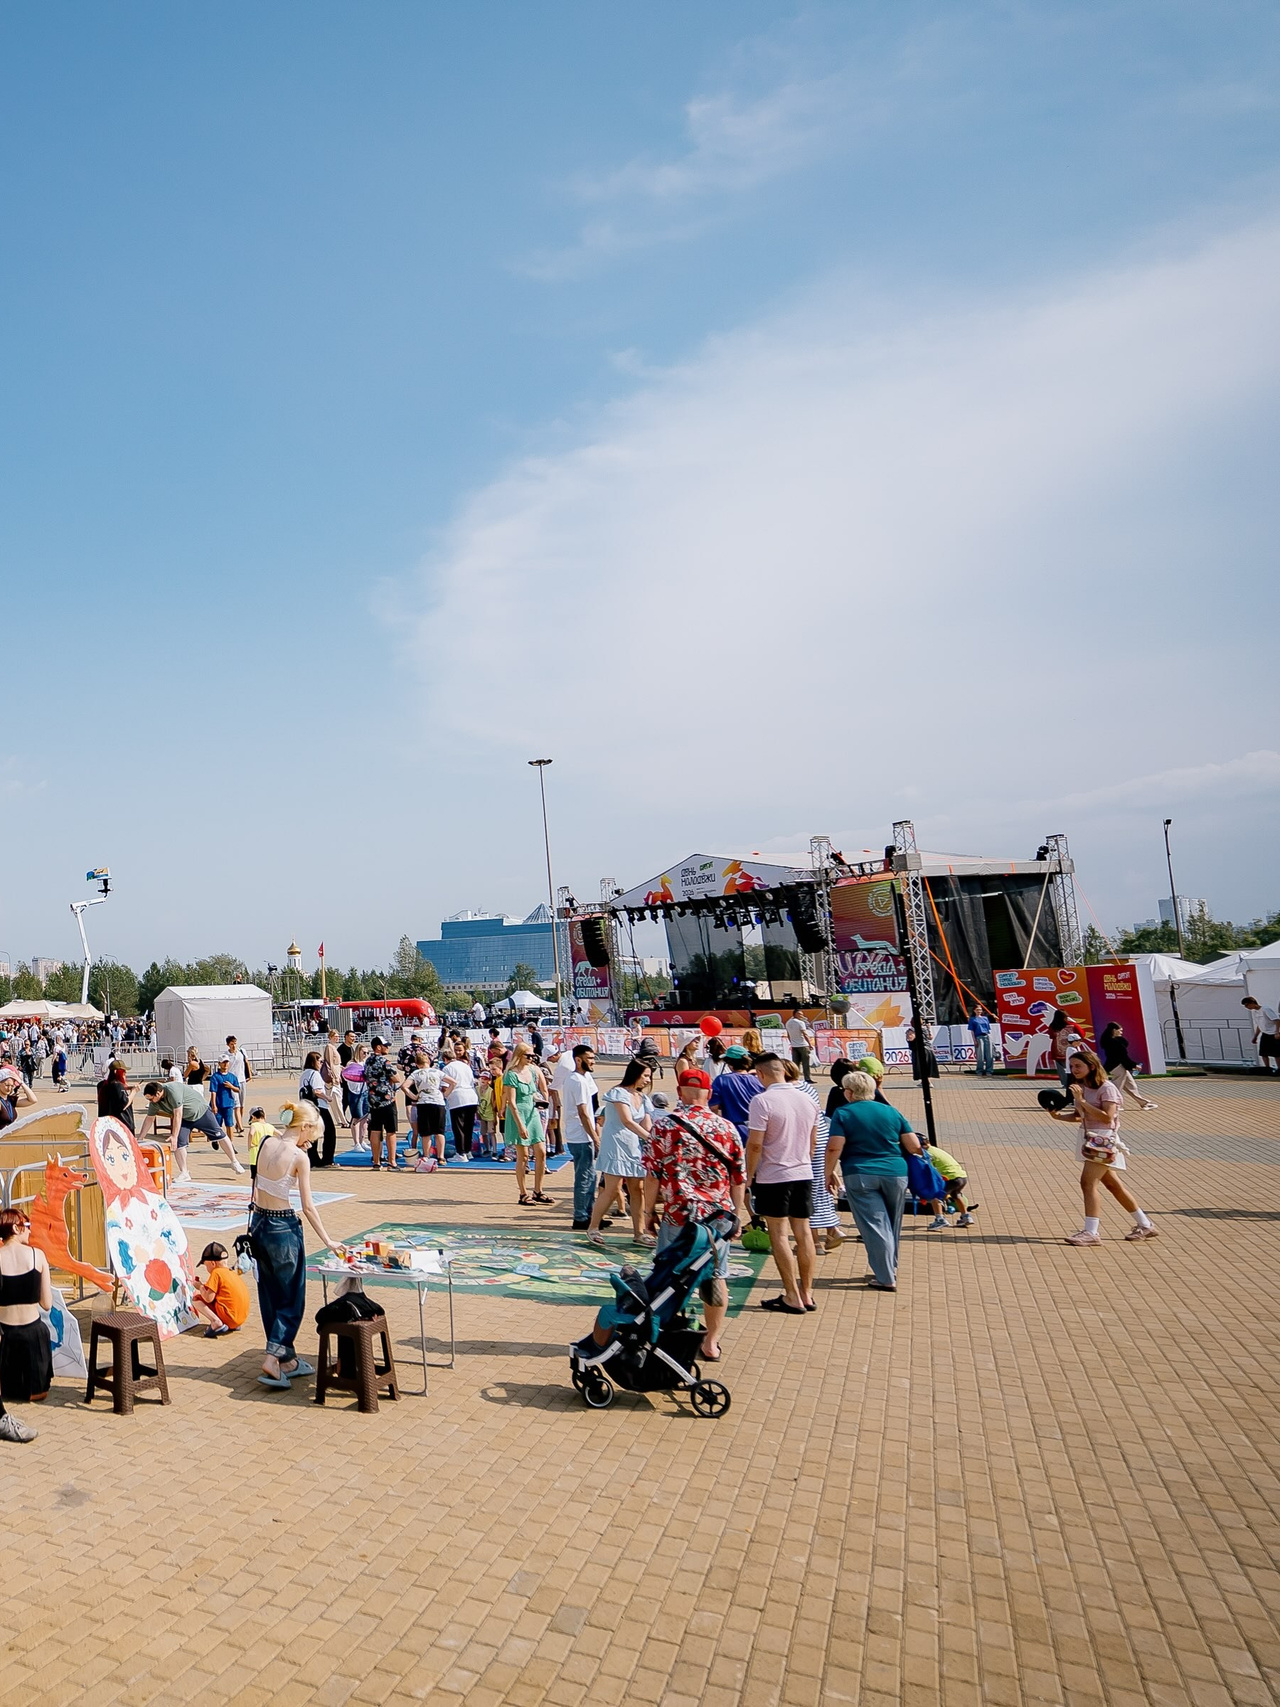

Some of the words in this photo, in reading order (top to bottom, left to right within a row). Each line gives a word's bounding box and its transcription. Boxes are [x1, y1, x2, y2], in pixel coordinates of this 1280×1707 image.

[845, 976, 907, 992] ОБИТАНИЯ
[577, 987, 609, 998] ОБИТАНИЯ
[885, 1050, 910, 1063] 2026
